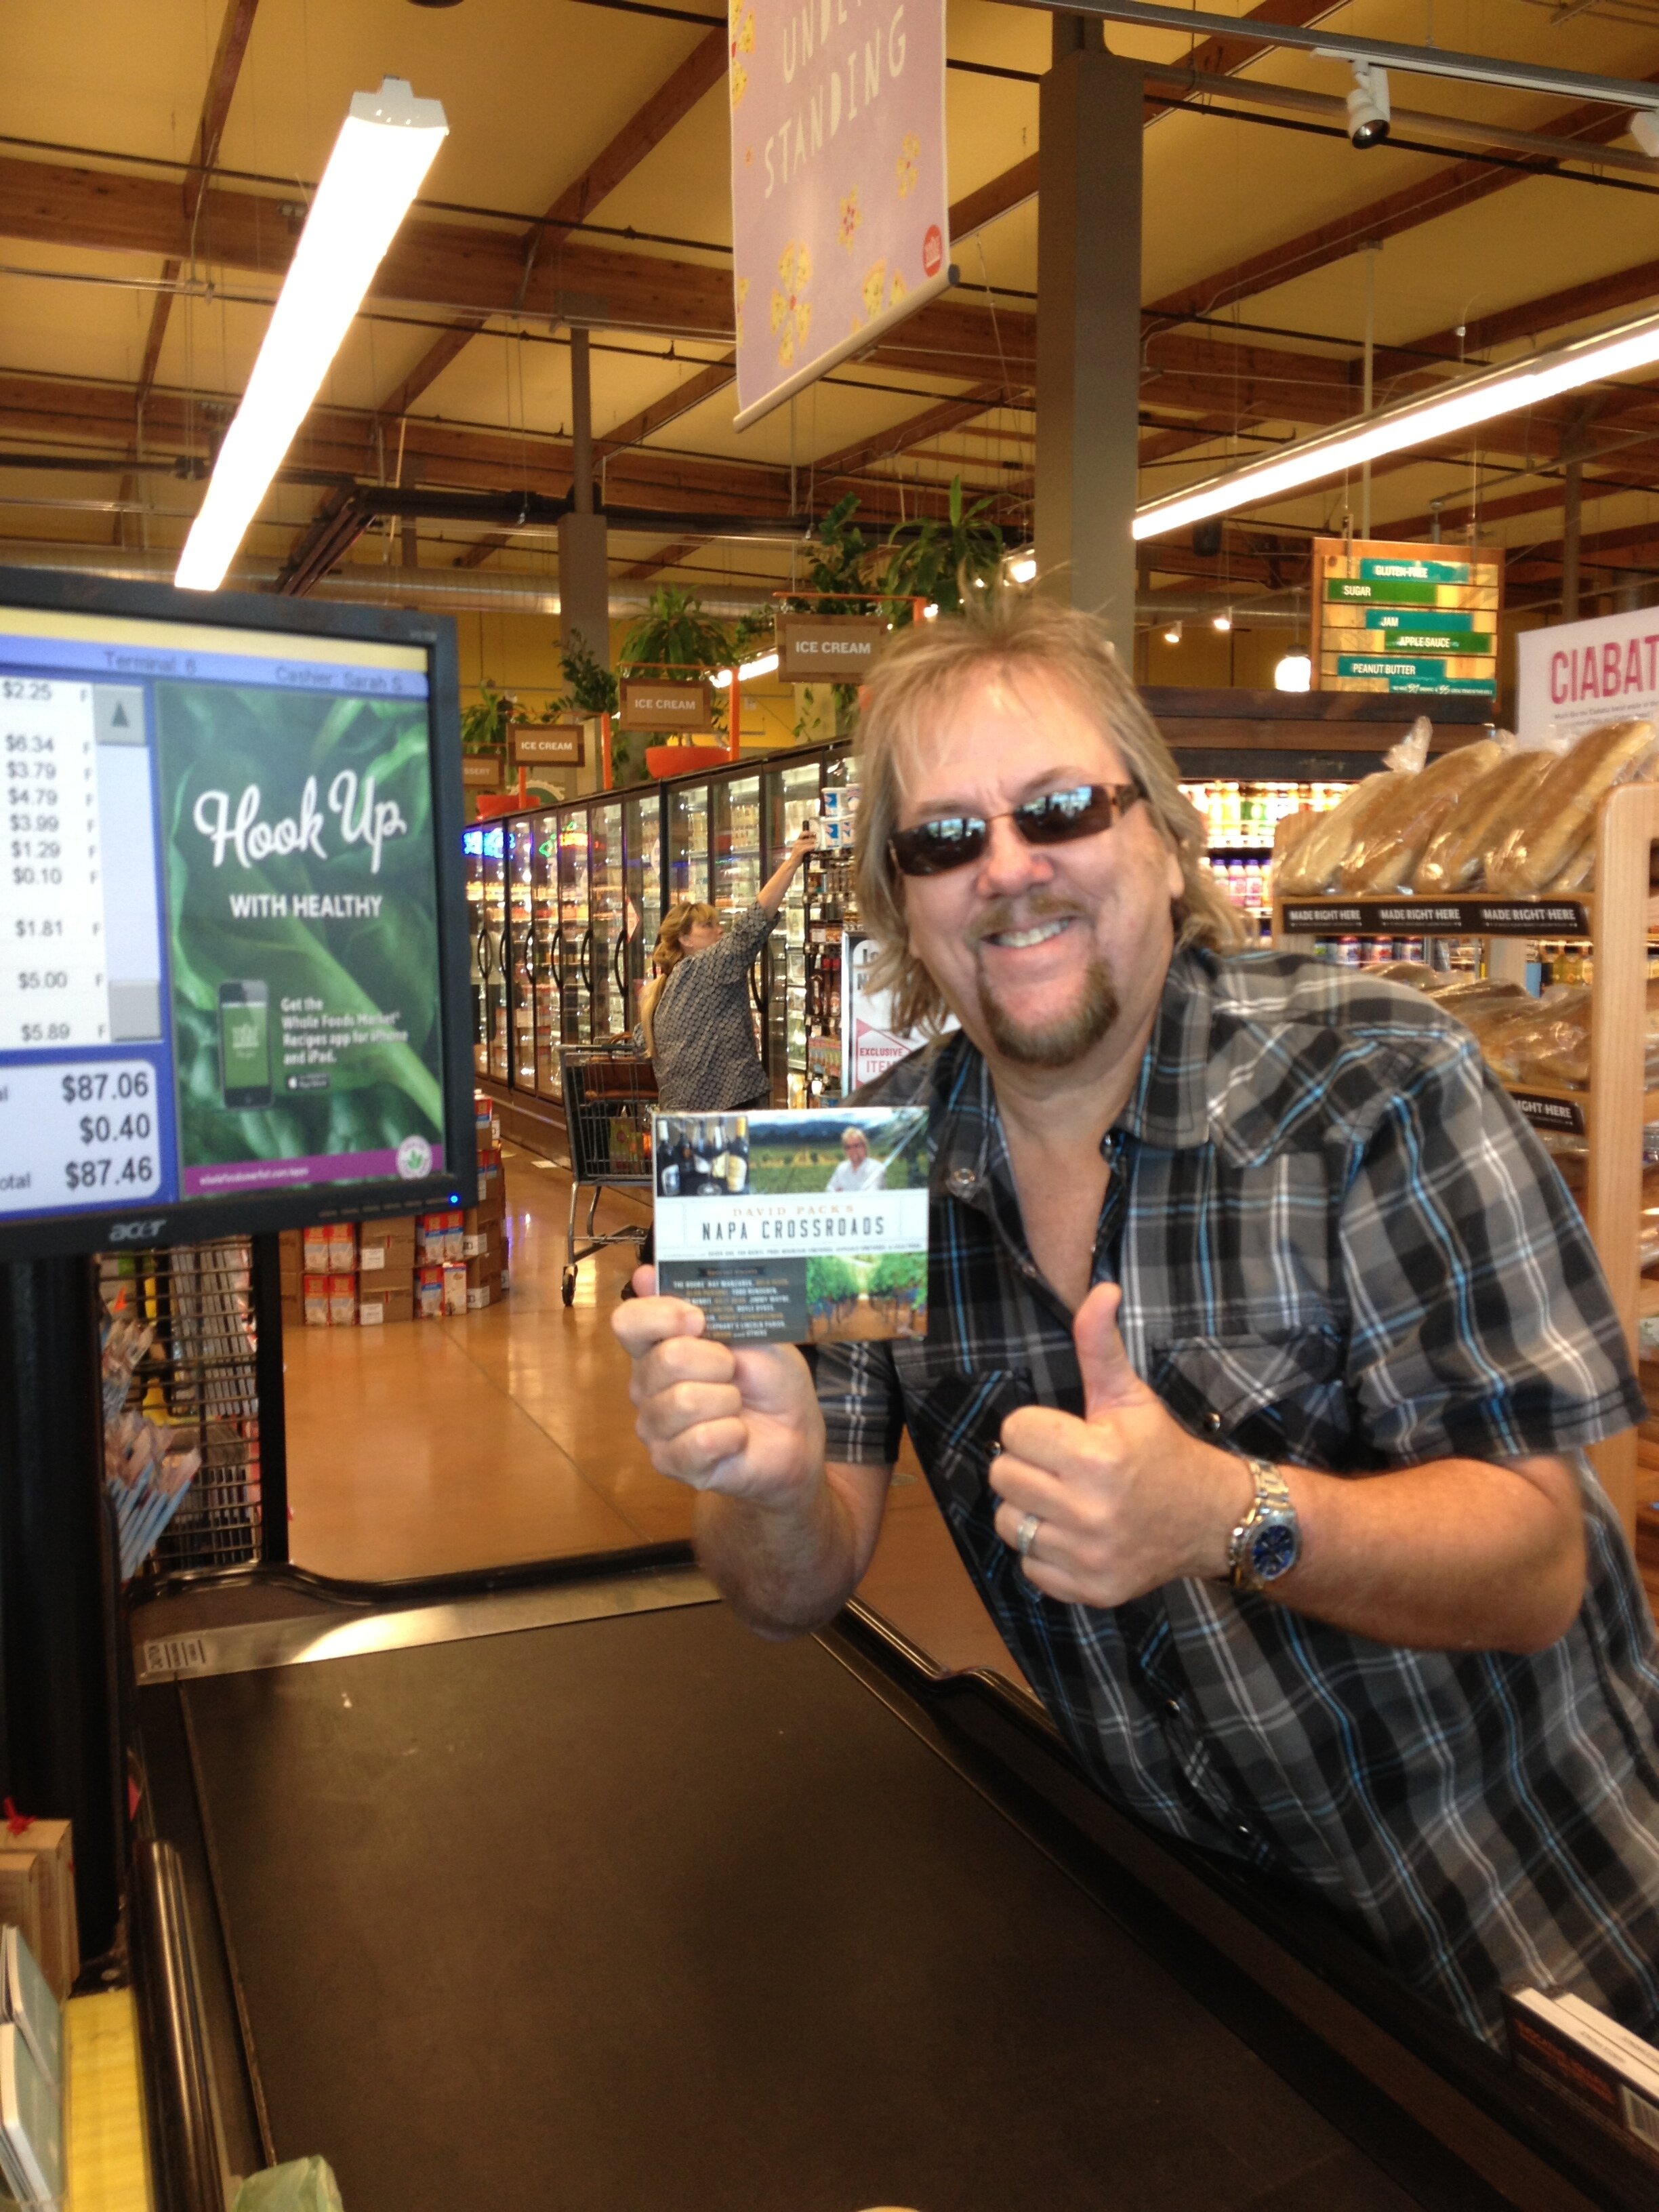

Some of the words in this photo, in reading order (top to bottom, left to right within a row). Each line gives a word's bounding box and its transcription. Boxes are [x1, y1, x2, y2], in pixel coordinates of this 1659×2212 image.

[764, 4, 906, 199] STANDING
[1374, 565, 1428, 578] GLUTEN-FREE
[1343, 586, 1372, 596] SUGAR
[1380, 617, 1399, 627] JAM
[795, 641, 818, 653] ICE
[821, 641, 872, 655] CREAM
[1398, 636, 1423, 647] APPLE
[1425, 638, 1450, 648] SAUCE
[1352, 663, 1384, 674] PEANUT
[1385, 665, 1416, 675] BUTTER
[3, 680, 52, 701] $2.25
[634, 699, 653, 710] ICE
[655, 699, 696, 711] CREAM
[520, 741, 537, 751] ICE
[538, 741, 573, 752] CREAM
[7, 760, 57, 779] $3.79
[8, 787, 58, 806] $4.79
[10, 813, 60, 833] $3.99
[193, 775, 327, 868] Hook
[327, 769, 407, 875] Up
[12, 840, 62, 859] $1.29
[12, 866, 63, 886] $0.10
[229, 895, 287, 918] WITH
[292, 895, 382, 918] HEALTHY
[1290, 910, 1313, 920] MADE
[1314, 910, 1338, 920] RIGHT
[1339, 909, 1361, 920] HERE
[1380, 909, 1406, 920] MADE
[1406, 909, 1434, 920] RIGHT
[1435, 909, 1460, 920] HERE
[1481, 909, 1511, 920] MADE
[1513, 909, 1545, 920] RIGHT
[1547, 909, 1576, 920] HERE
[15, 919, 63, 938] $1.81
[18, 970, 67, 990] $5.00
[21, 1023, 70, 1043] $5.89
[859, 1047, 903, 1057] EXCLUSIVE
[62, 1073, 149, 1103] $87.06
[1516, 1099, 1543, 1114] IGHT
[1545, 1104, 1572, 1118] HERE
[79, 1114, 150, 1145] $0.40
[65, 1156, 153, 1189] $87.46
[733, 1207, 786, 1217] DAVID
[108, 1218, 167, 1242] acer
[702, 1221, 748, 1242] NAPA
[762, 1216, 884, 1240] CROSSROADS
